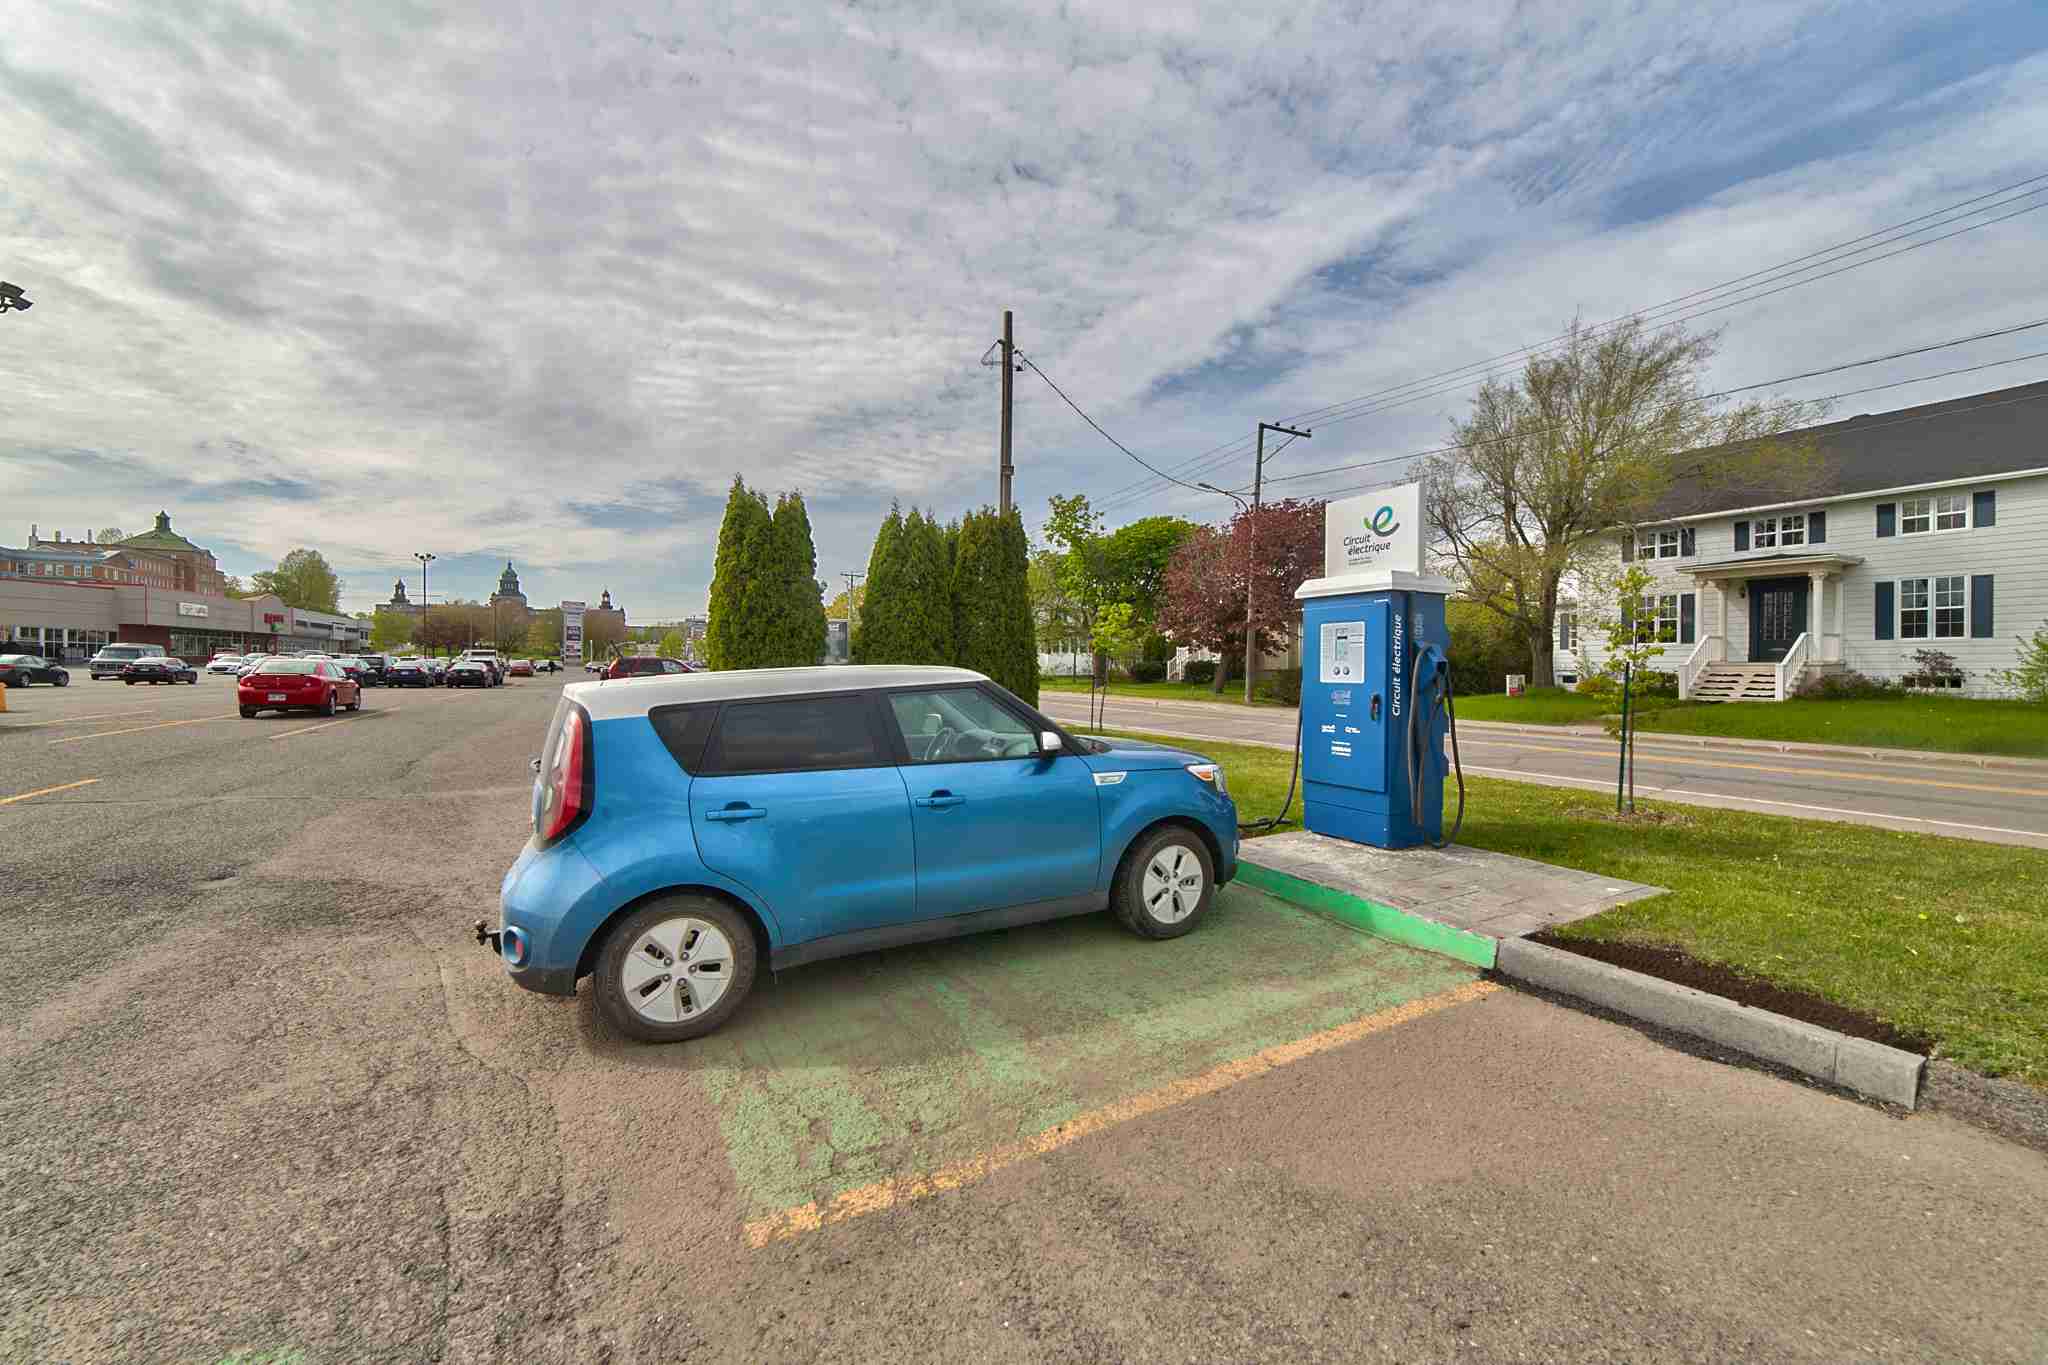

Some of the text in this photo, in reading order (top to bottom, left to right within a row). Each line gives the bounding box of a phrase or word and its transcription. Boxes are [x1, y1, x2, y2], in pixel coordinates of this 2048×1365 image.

[1343, 534, 1371, 547] Circuit
[1347, 542, 1392, 556] électrique
[1392, 613, 1403, 717] Circuit électrique
